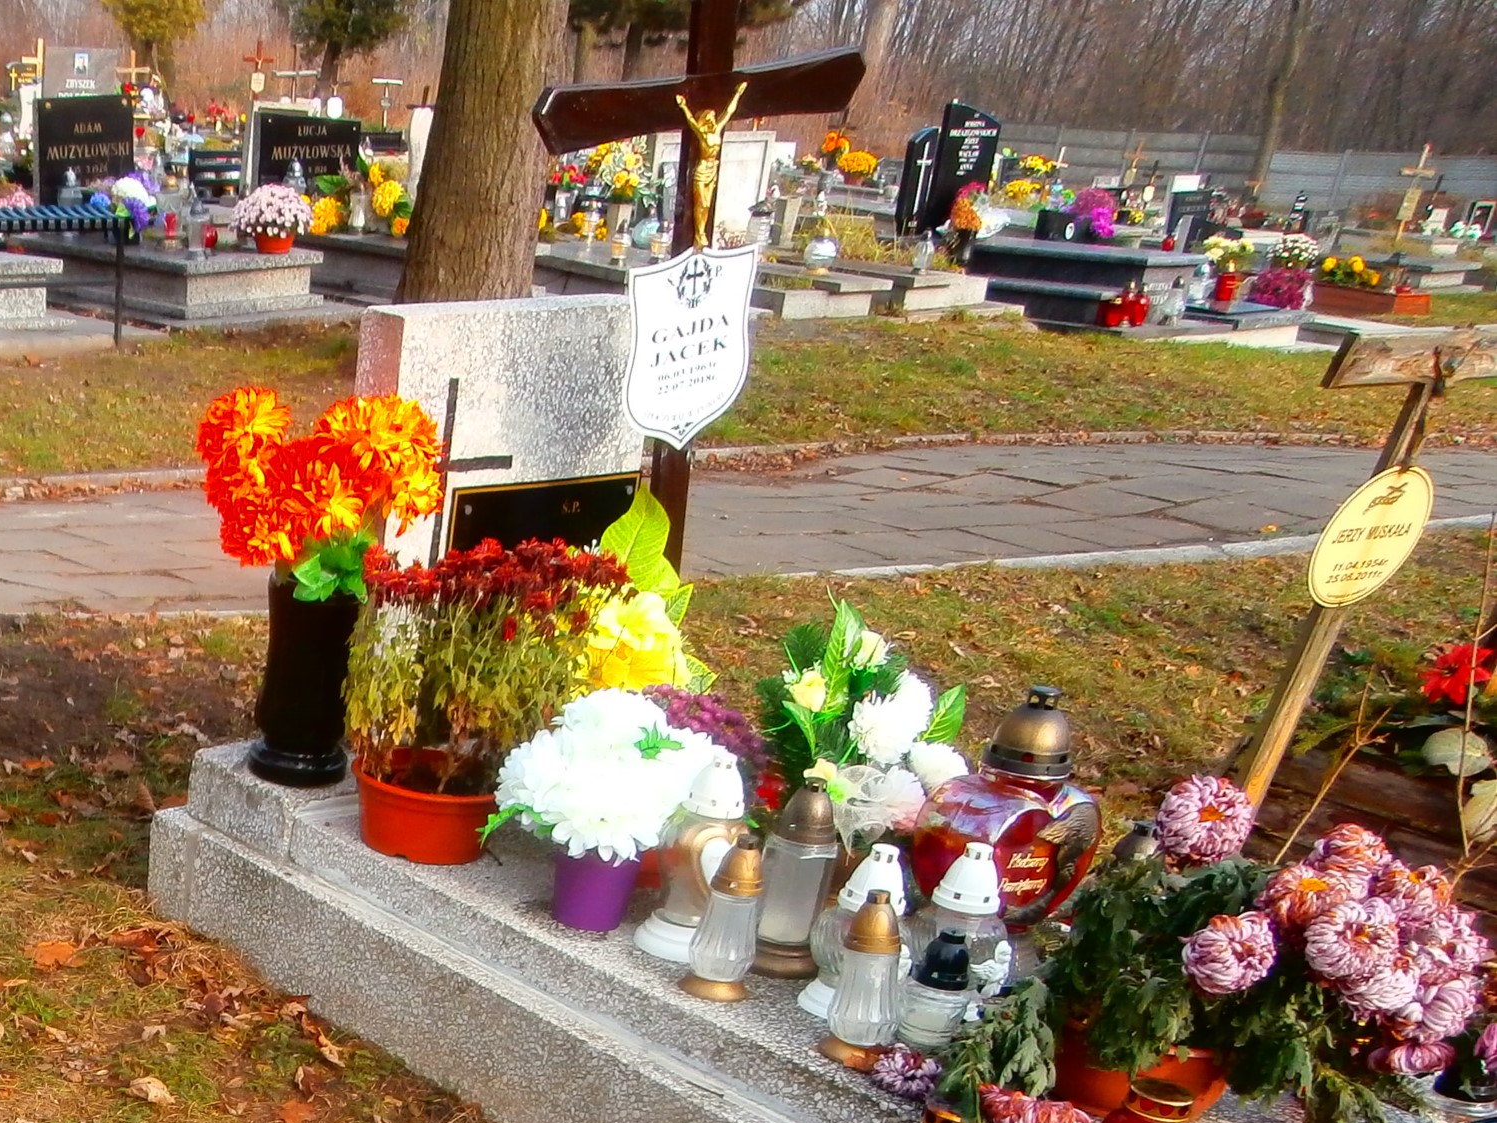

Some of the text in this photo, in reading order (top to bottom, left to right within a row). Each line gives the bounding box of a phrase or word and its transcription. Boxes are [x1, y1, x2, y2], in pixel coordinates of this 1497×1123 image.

[73, 122, 103, 134] ADAM
[651, 314, 730, 345] GAJDA
[650, 335, 727, 367] JACEK
[1331, 527, 1366, 544] JERZY
